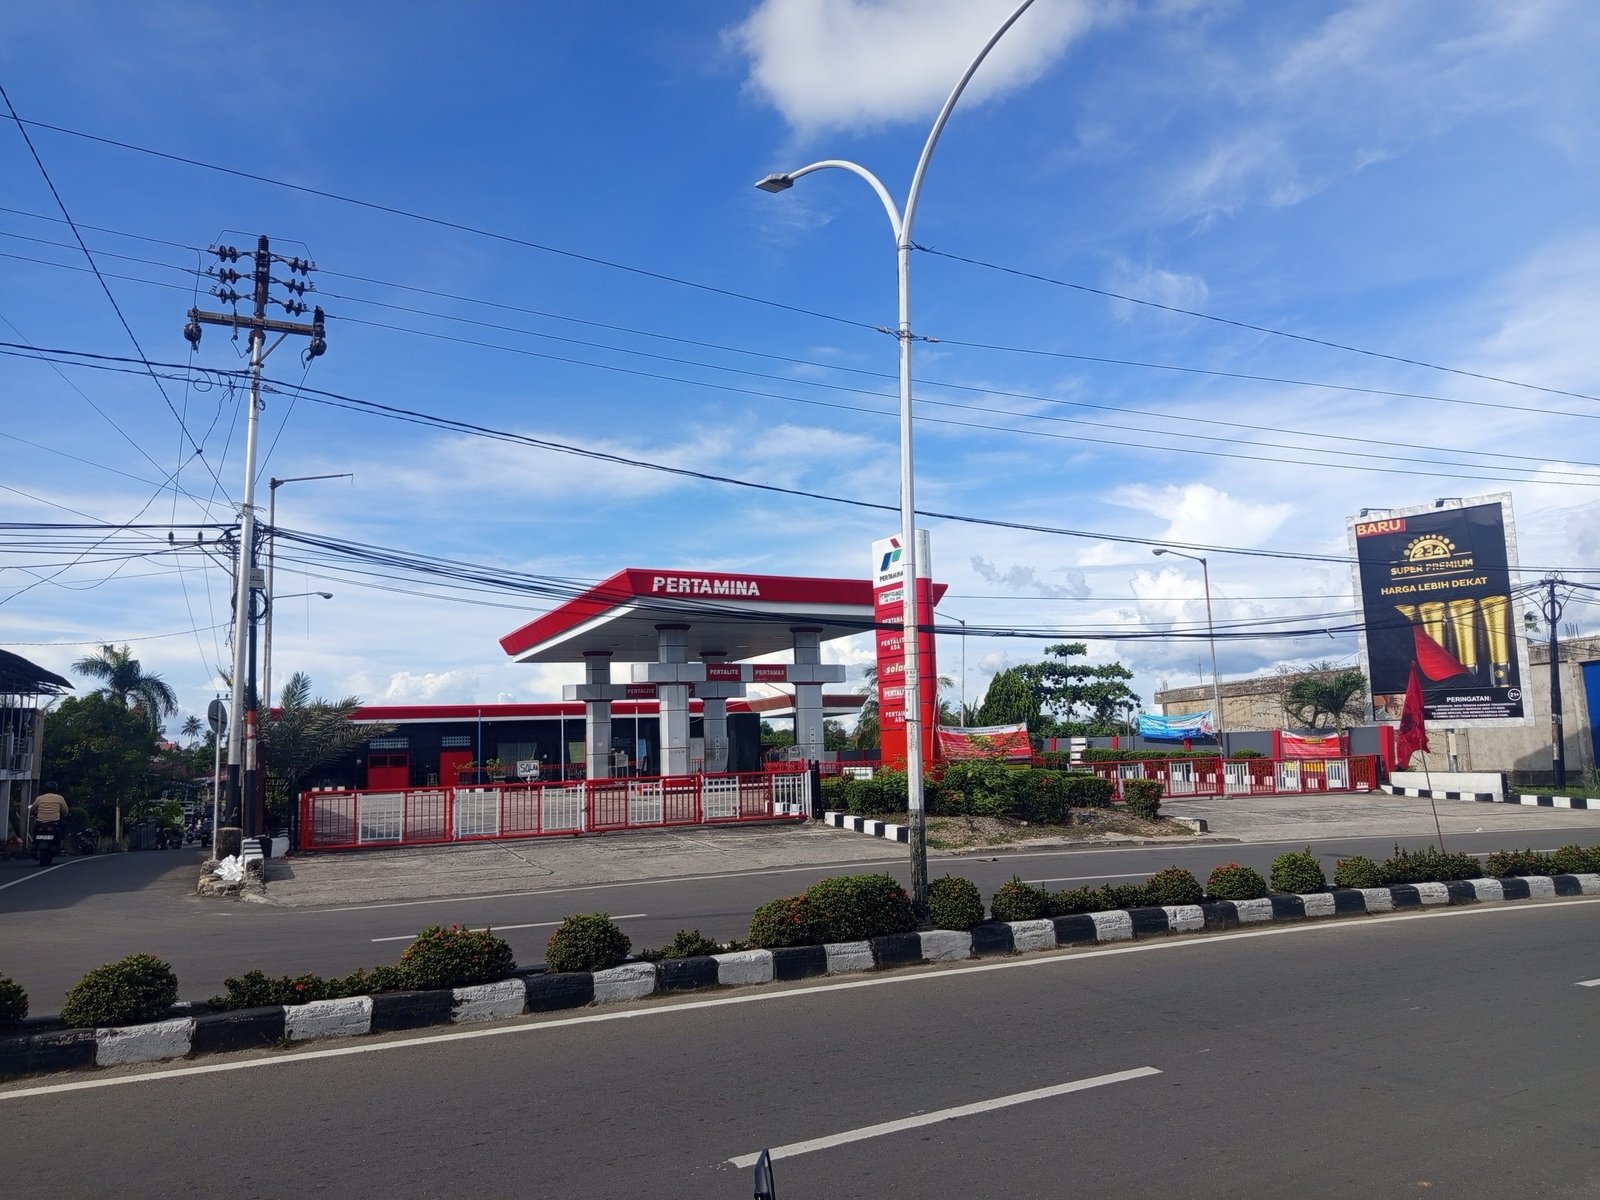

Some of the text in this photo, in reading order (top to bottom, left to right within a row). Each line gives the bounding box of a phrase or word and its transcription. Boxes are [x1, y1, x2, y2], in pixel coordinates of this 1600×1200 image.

[1356, 519, 1400, 536] BARU
[1414, 545, 1445, 558] 234
[1390, 559, 1473, 576] SUPER PREMIUM
[652, 576, 760, 596] PERTAMINA
[1381, 576, 1488, 595] HARGA LEBIH DEKAT
[880, 637, 905, 647] PERTALIT
[1446, 695, 1492, 703] PERINGATAN:
